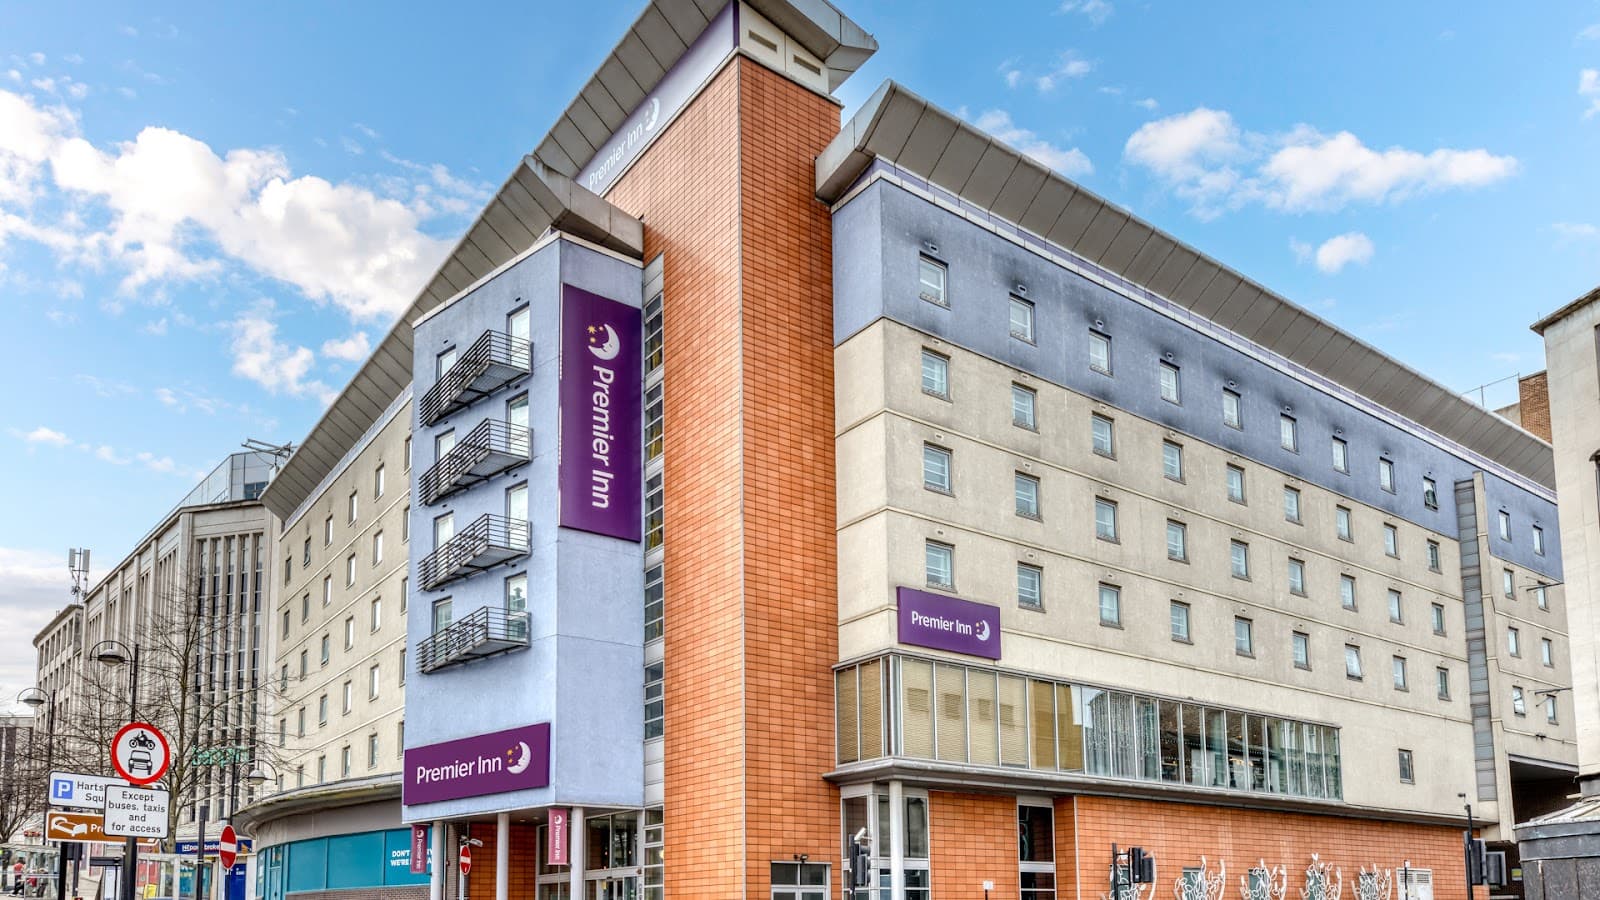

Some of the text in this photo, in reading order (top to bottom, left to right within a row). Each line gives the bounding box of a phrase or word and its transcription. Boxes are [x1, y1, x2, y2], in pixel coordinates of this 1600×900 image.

[589, 122, 643, 190] Premier Inn
[592, 365, 615, 509] Premier Inn
[911, 610, 972, 635] Premier Inn
[416, 755, 502, 785] Premier Inn
[77, 781, 105, 792] Harts
[85, 792, 104, 804] Squ
[122, 790, 154, 802] Except
[143, 803, 166, 813] taxis
[128, 813, 146, 822] and
[112, 822, 161, 834] for access
[391, 849, 410, 858] DON'T
